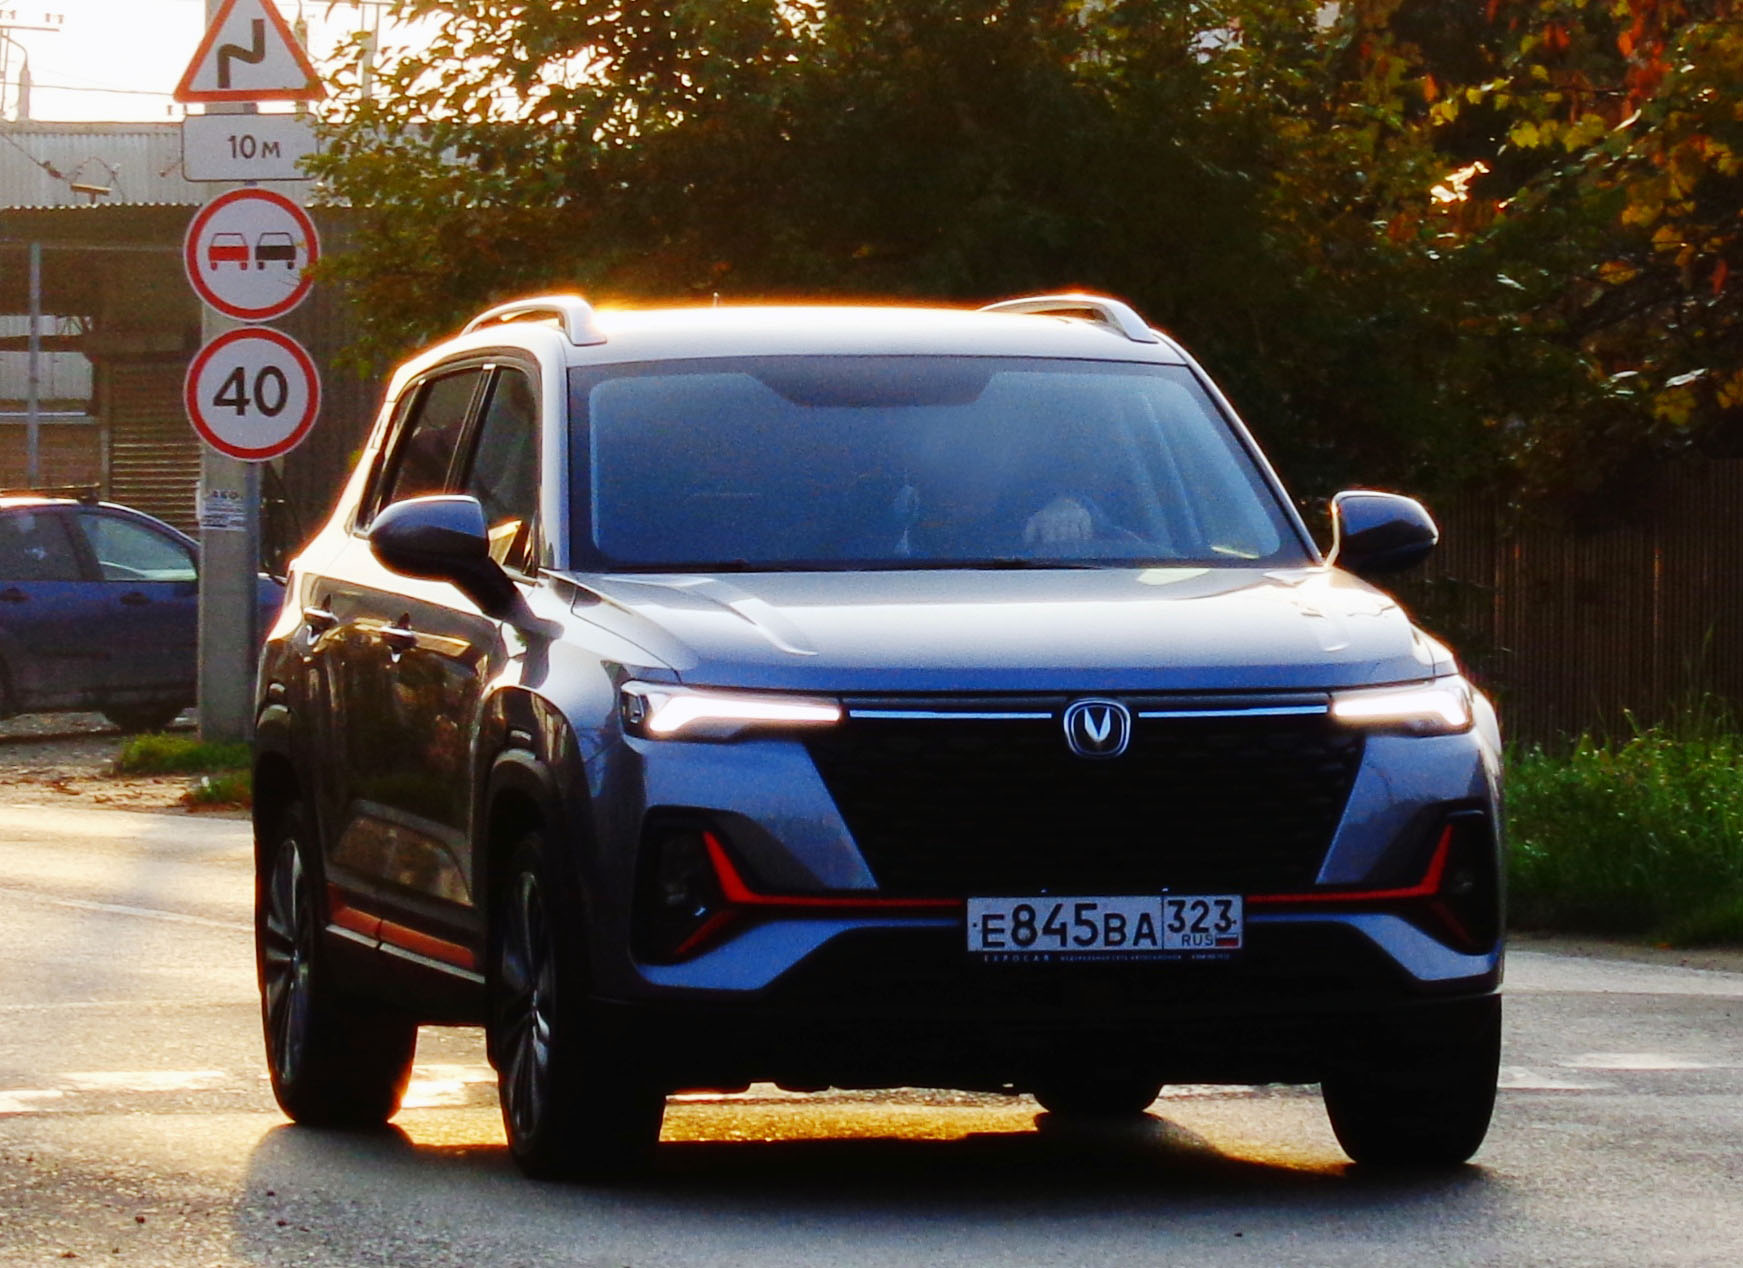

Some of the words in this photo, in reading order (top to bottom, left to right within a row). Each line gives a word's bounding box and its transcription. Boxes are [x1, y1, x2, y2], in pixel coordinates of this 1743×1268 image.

[228, 134, 256, 159] 10
[213, 365, 288, 417] 40
[1166, 899, 1233, 934] 323
[1181, 934, 1213, 946] RUS
